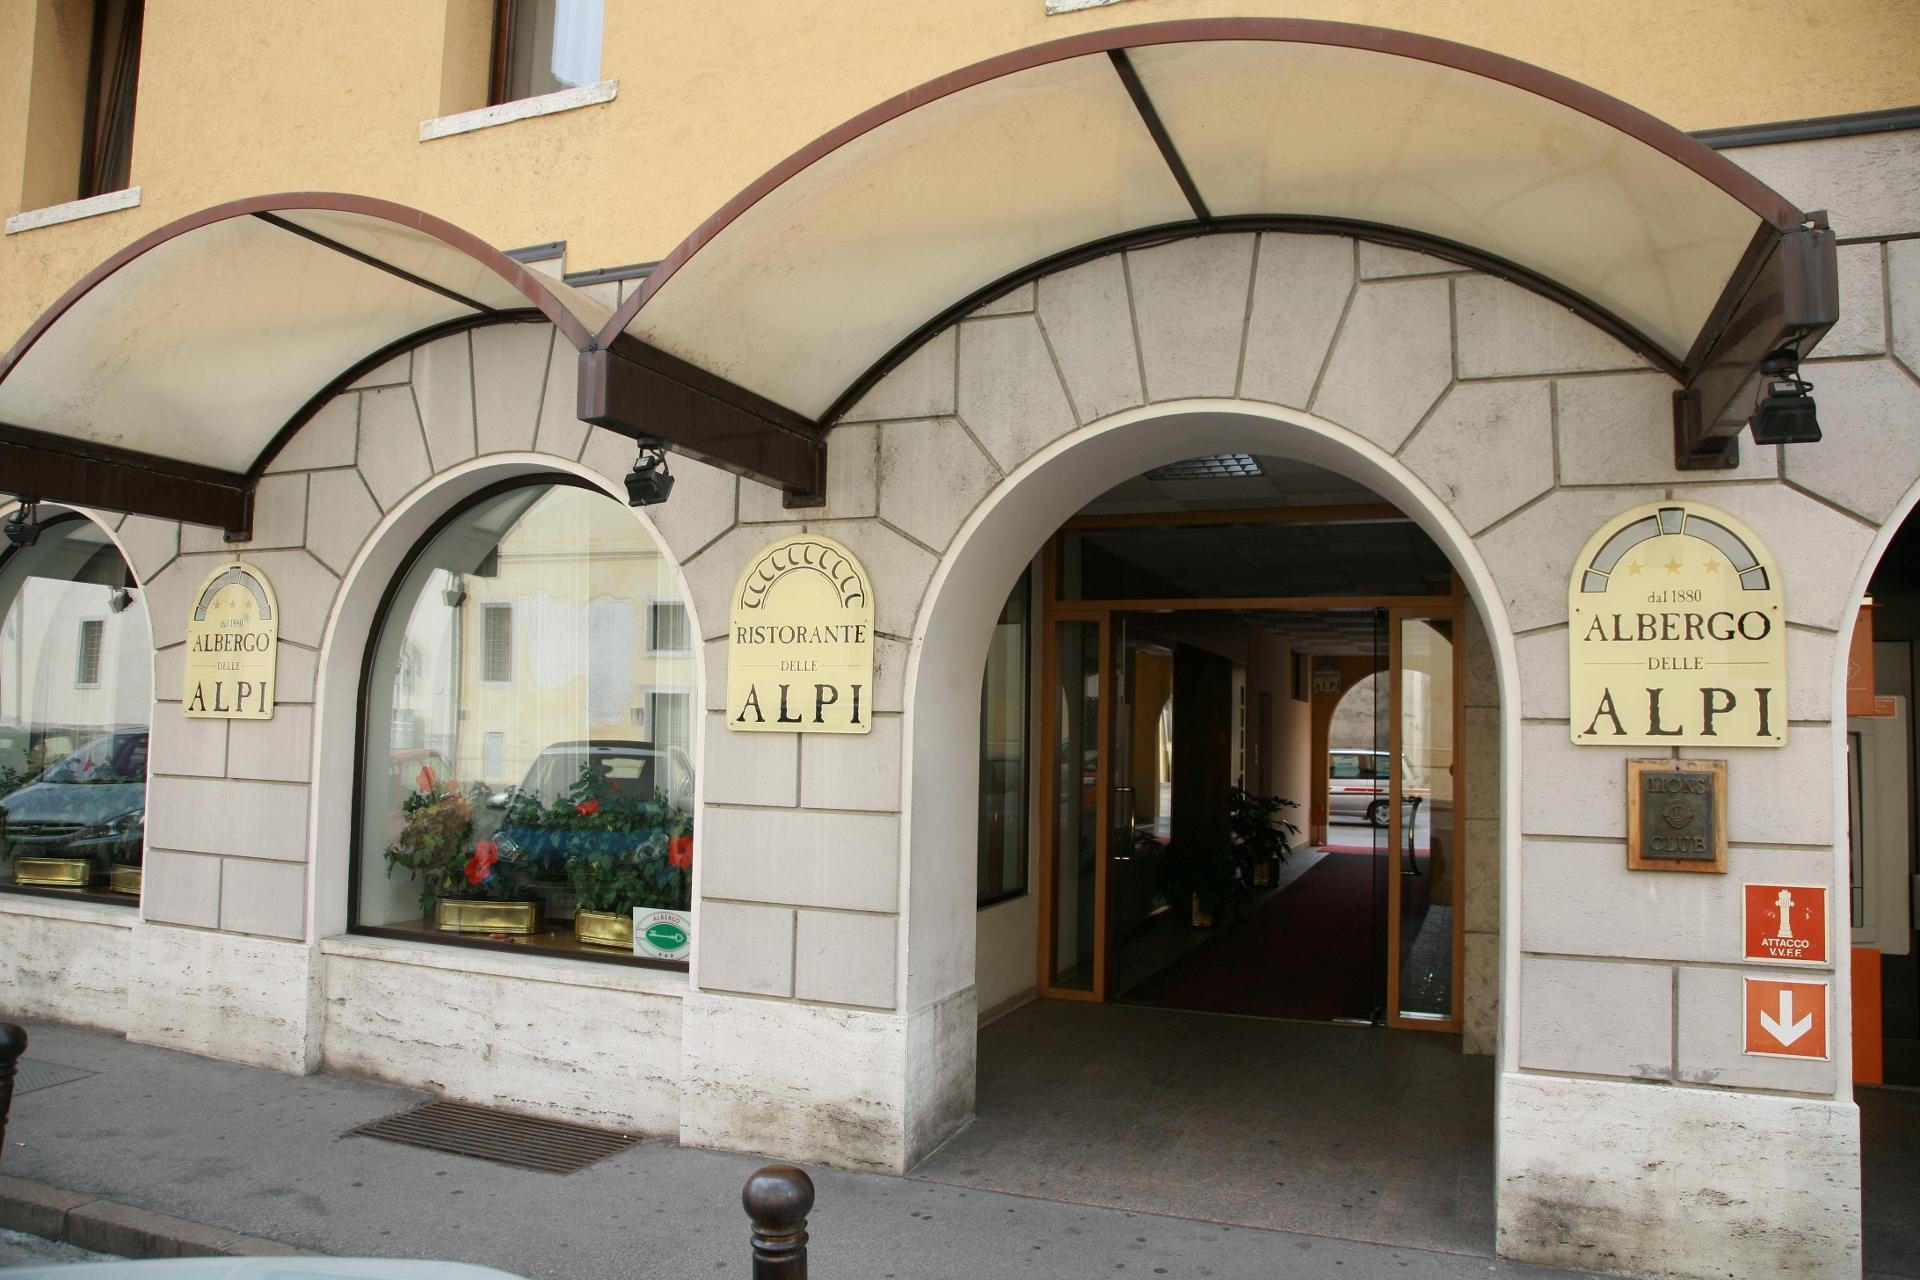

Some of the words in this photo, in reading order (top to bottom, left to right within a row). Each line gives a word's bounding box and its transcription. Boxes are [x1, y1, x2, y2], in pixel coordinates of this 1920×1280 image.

[1647, 590, 1667, 603] dal
[1671, 589, 1702, 603] 1880
[736, 624, 866, 645] RISTORANTE
[1583, 610, 1771, 642] ALBERGO
[192, 632, 270, 652] ALBERGO
[217, 661, 241, 671] DELLE
[781, 660, 818, 672] DELLE
[1647, 656, 1704, 671] DELLE
[188, 680, 268, 713] ALPI
[736, 683, 863, 724] ALPI
[1583, 687, 1773, 737] ALPI
[1648, 776, 1706, 795] LIONS
[1648, 837, 1705, 853] CLUB
[1761, 938, 1810, 949] ATTACCO
